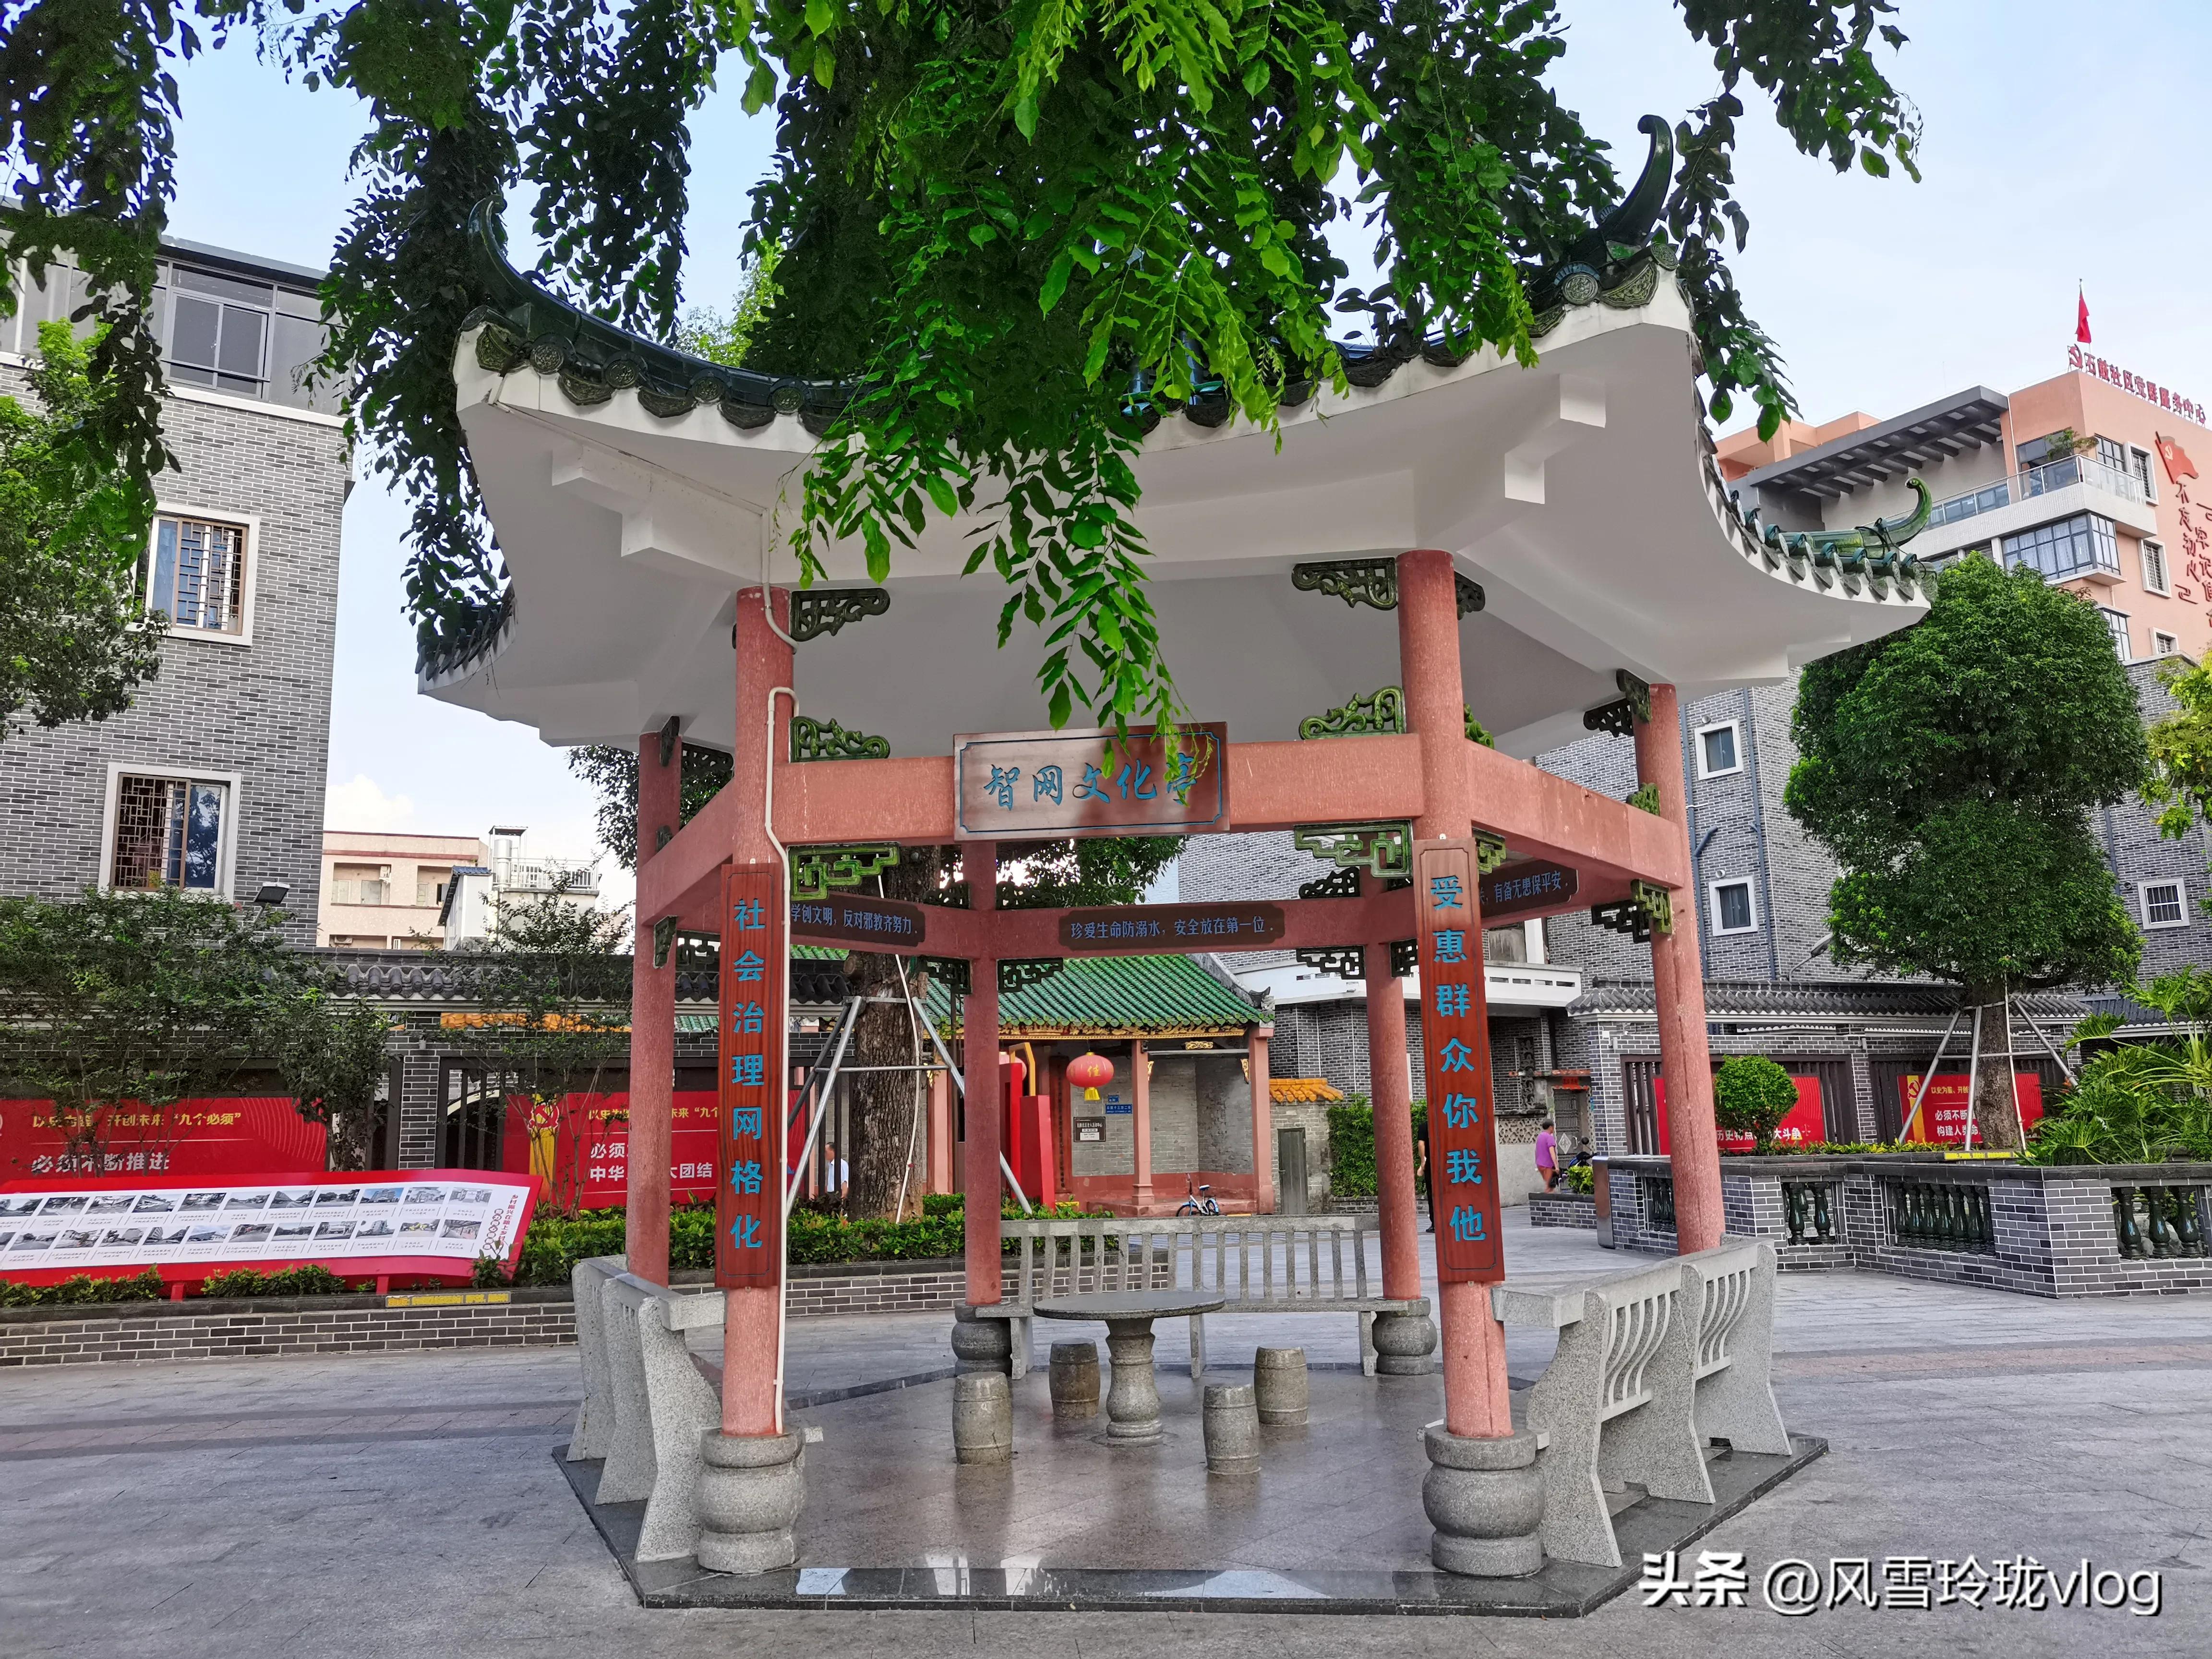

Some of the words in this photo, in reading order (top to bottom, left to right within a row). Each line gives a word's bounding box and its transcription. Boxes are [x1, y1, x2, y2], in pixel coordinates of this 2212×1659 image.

[984, 753, 1197, 811] 智网文化亭
[730, 899, 766, 1250] 社会治理网格化
[1430, 875, 1487, 1242] 受惠群众你我他
[590, 1142, 628, 1159] 必须
[590, 1165, 627, 1182] 中华
